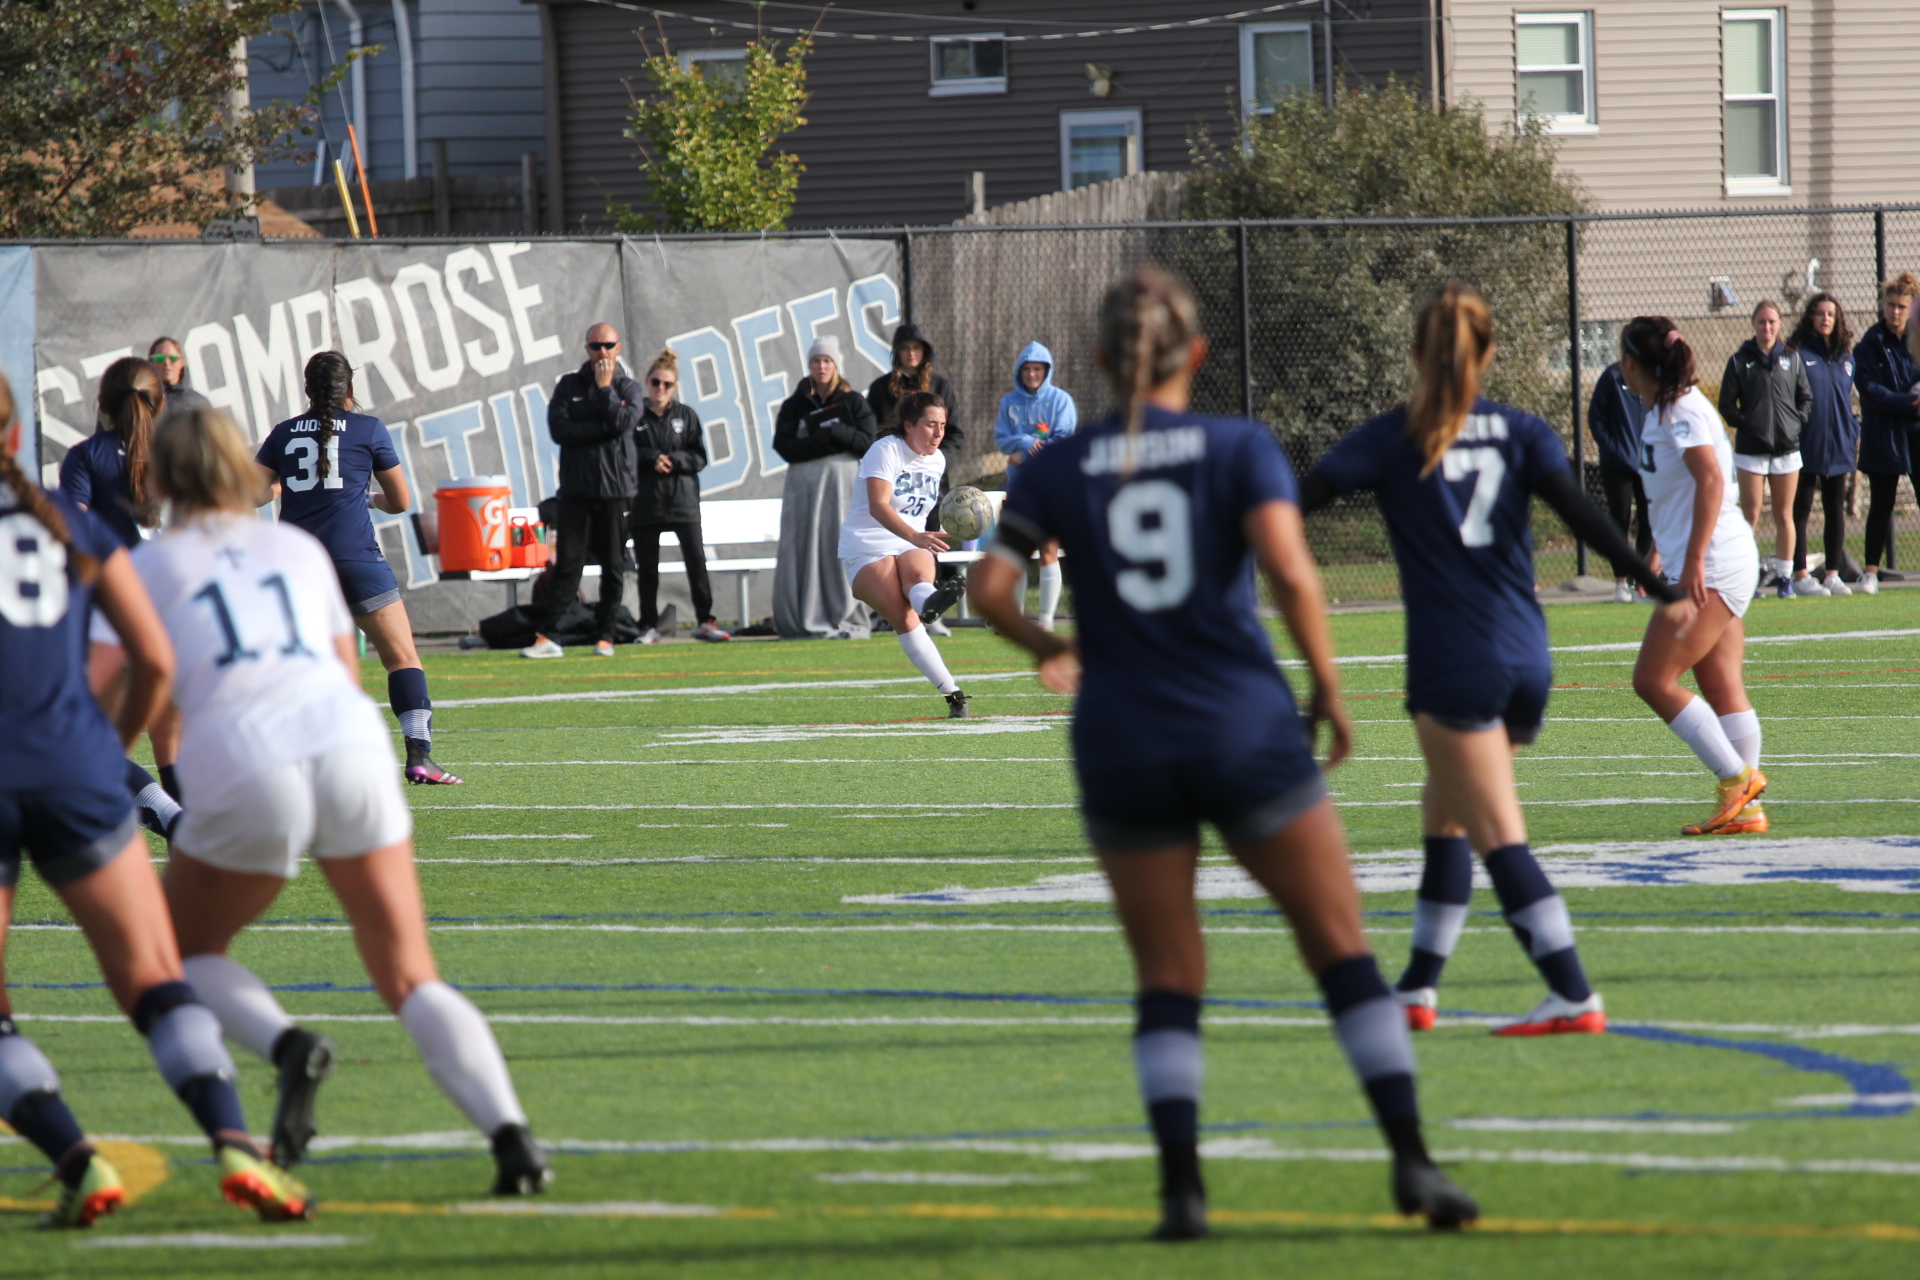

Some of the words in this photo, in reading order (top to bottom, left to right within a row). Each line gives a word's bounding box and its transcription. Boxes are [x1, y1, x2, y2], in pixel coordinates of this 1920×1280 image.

[290, 419, 347, 433] JUDON
[285, 435, 343, 492] 31
[484, 500, 503, 525] G
[900, 496, 926, 517] 25
[1442, 446, 1507, 547] 7
[1109, 479, 1194, 612] 9
[191, 571, 317, 667] 11
